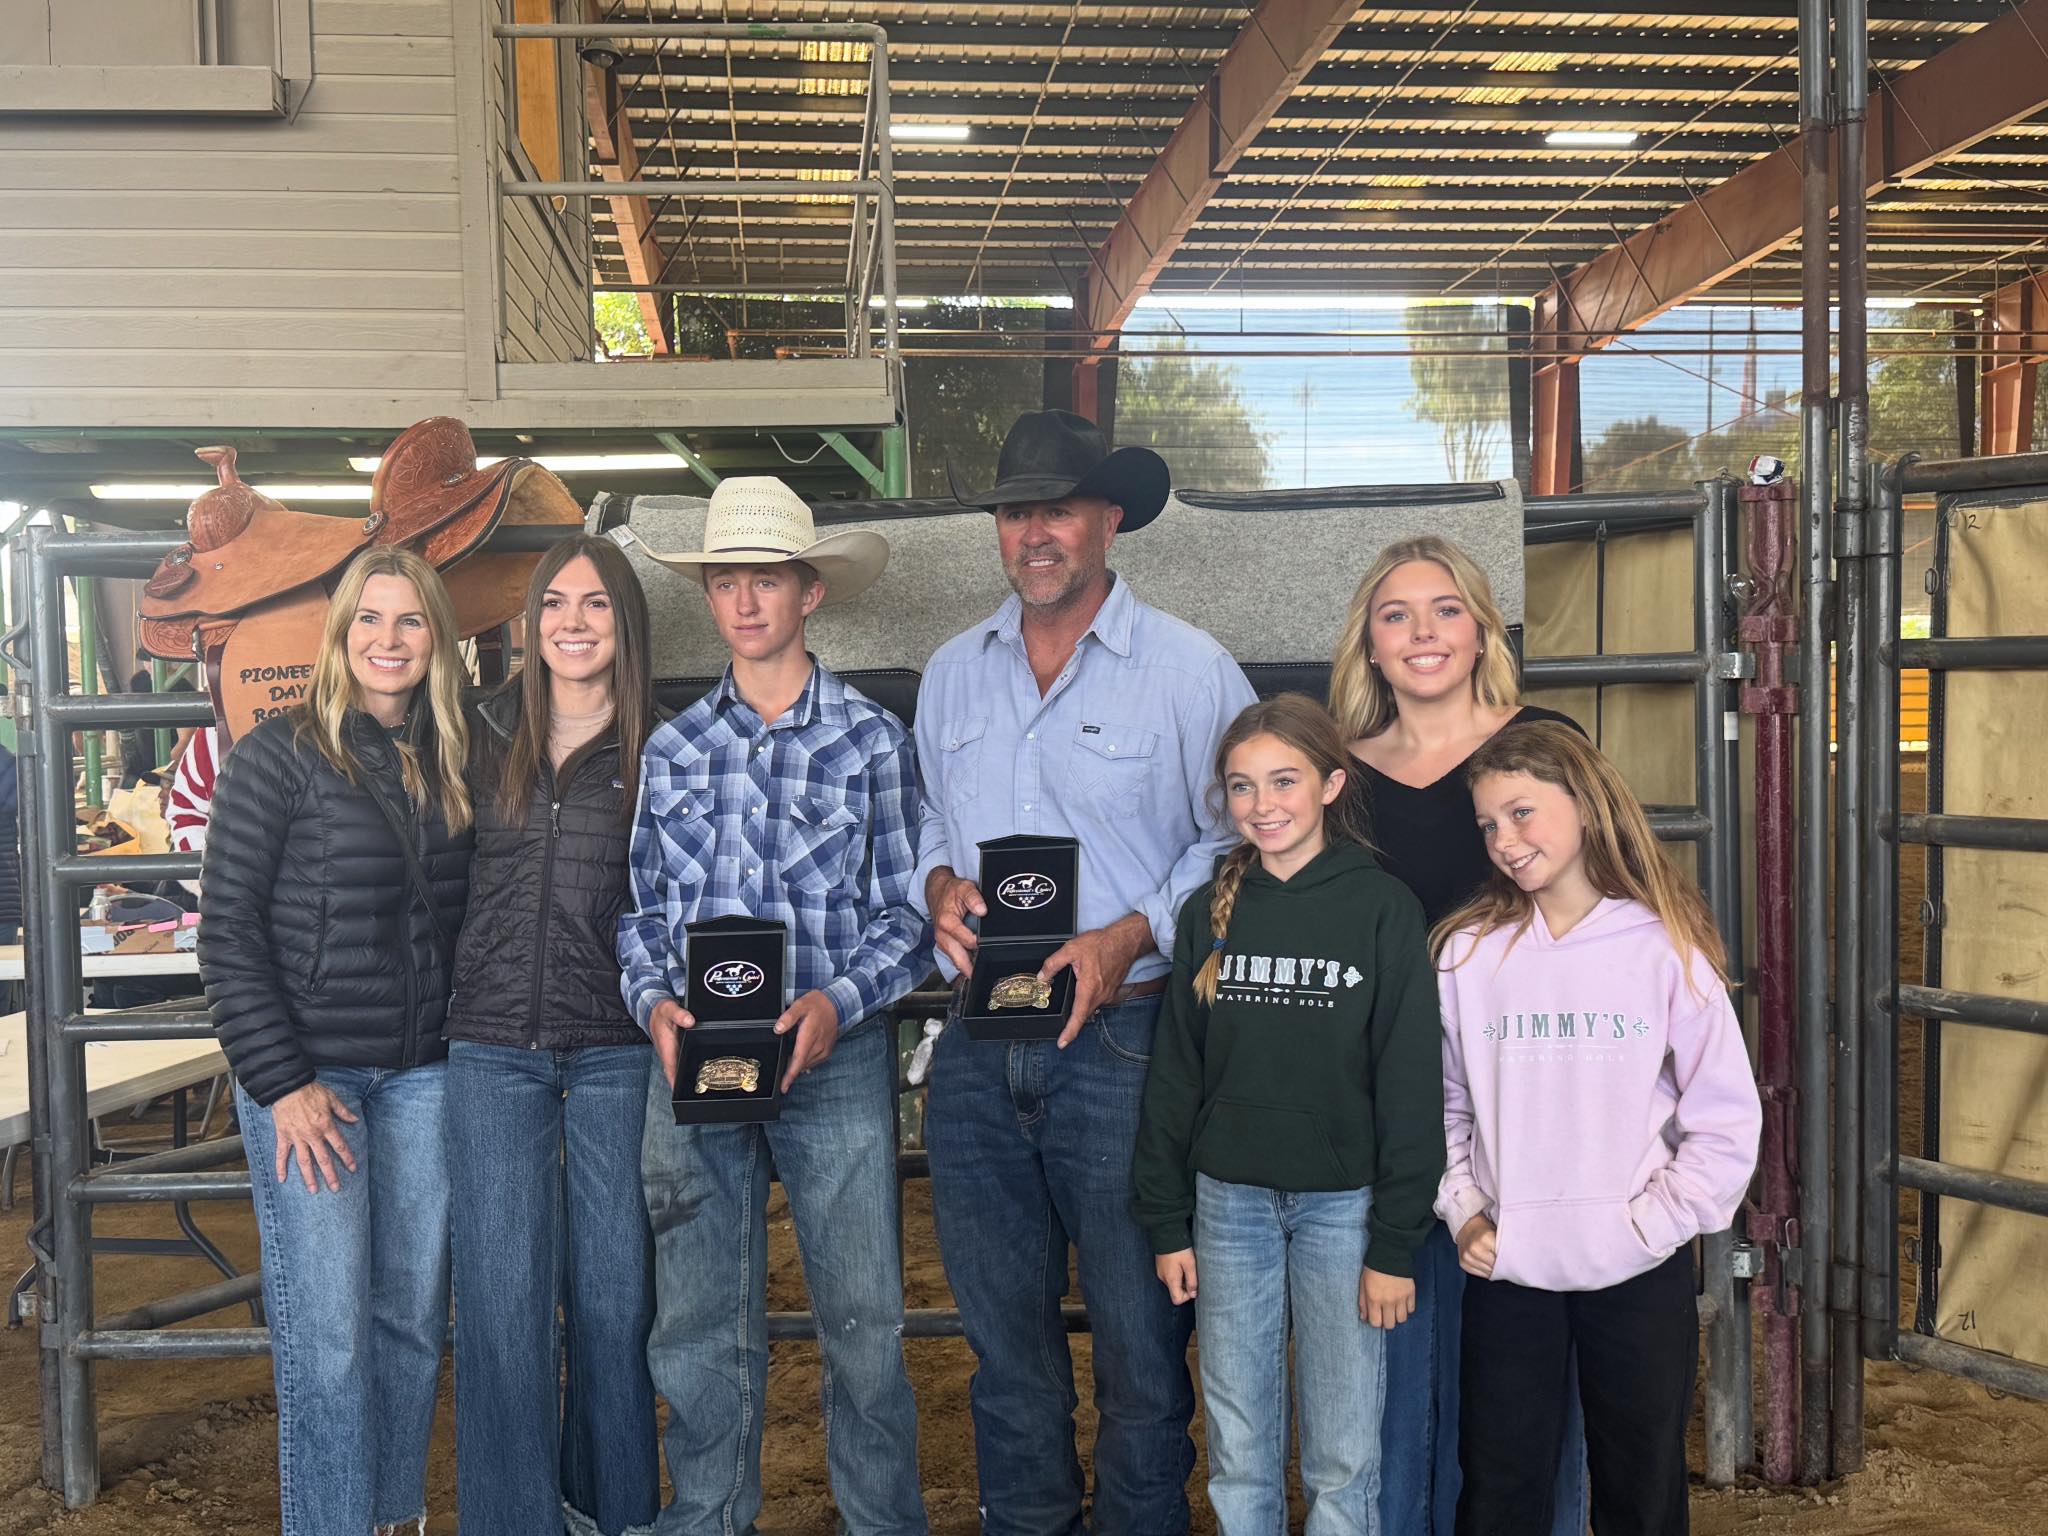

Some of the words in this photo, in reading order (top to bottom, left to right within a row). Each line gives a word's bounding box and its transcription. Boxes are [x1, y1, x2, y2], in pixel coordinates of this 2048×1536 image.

[1964, 514, 1983, 529] 12
[240, 663, 315, 684] PIONEE
[269, 684, 308, 701] DAY
[1217, 954, 1340, 988] JIMMY'S
[1216, 993, 1290, 1005] WATERING
[1299, 999, 1334, 1008] HOLE
[1498, 1011, 1626, 1041] JIMMY'S
